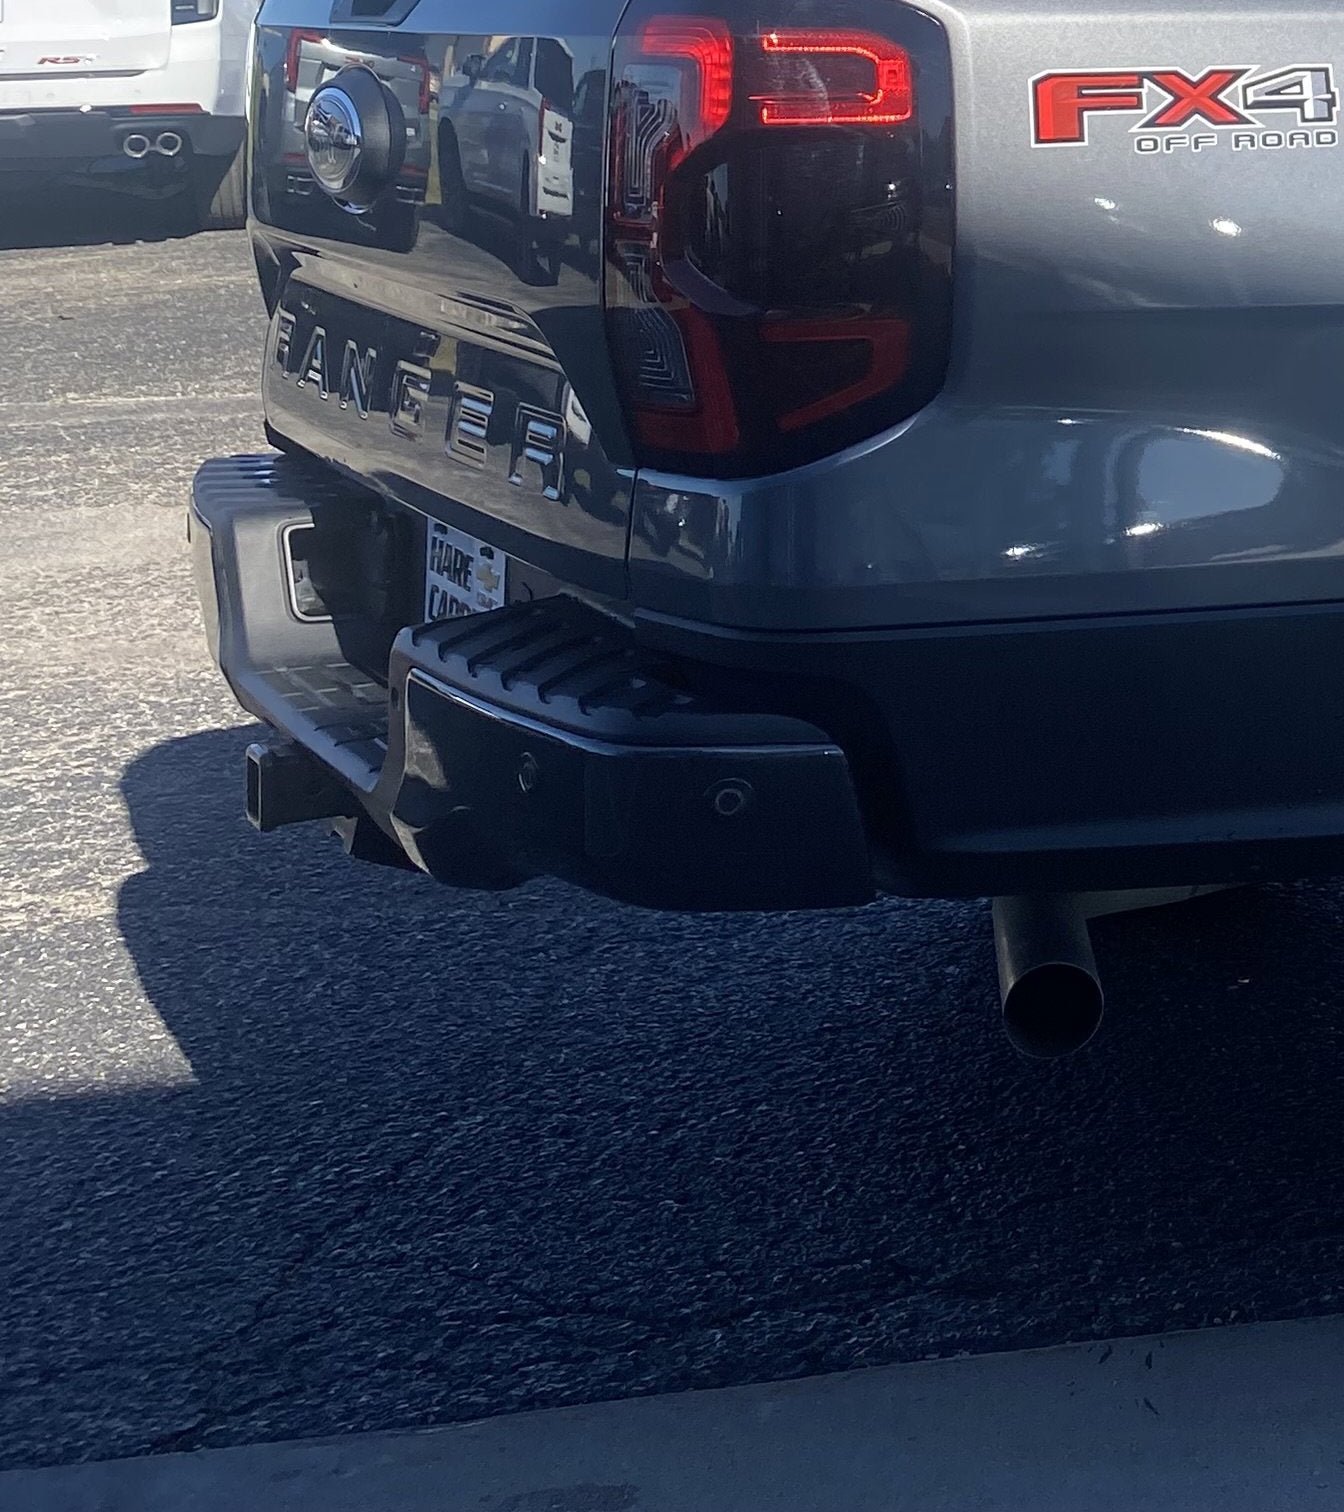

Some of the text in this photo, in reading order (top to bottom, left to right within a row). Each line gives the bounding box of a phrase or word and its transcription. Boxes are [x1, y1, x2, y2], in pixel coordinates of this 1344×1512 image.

[1028, 64, 1340, 148] FX4
[1134, 130, 1339, 154] OFF ROAD
[272, 305, 568, 501] RANGER
[429, 535, 475, 593] HARE
